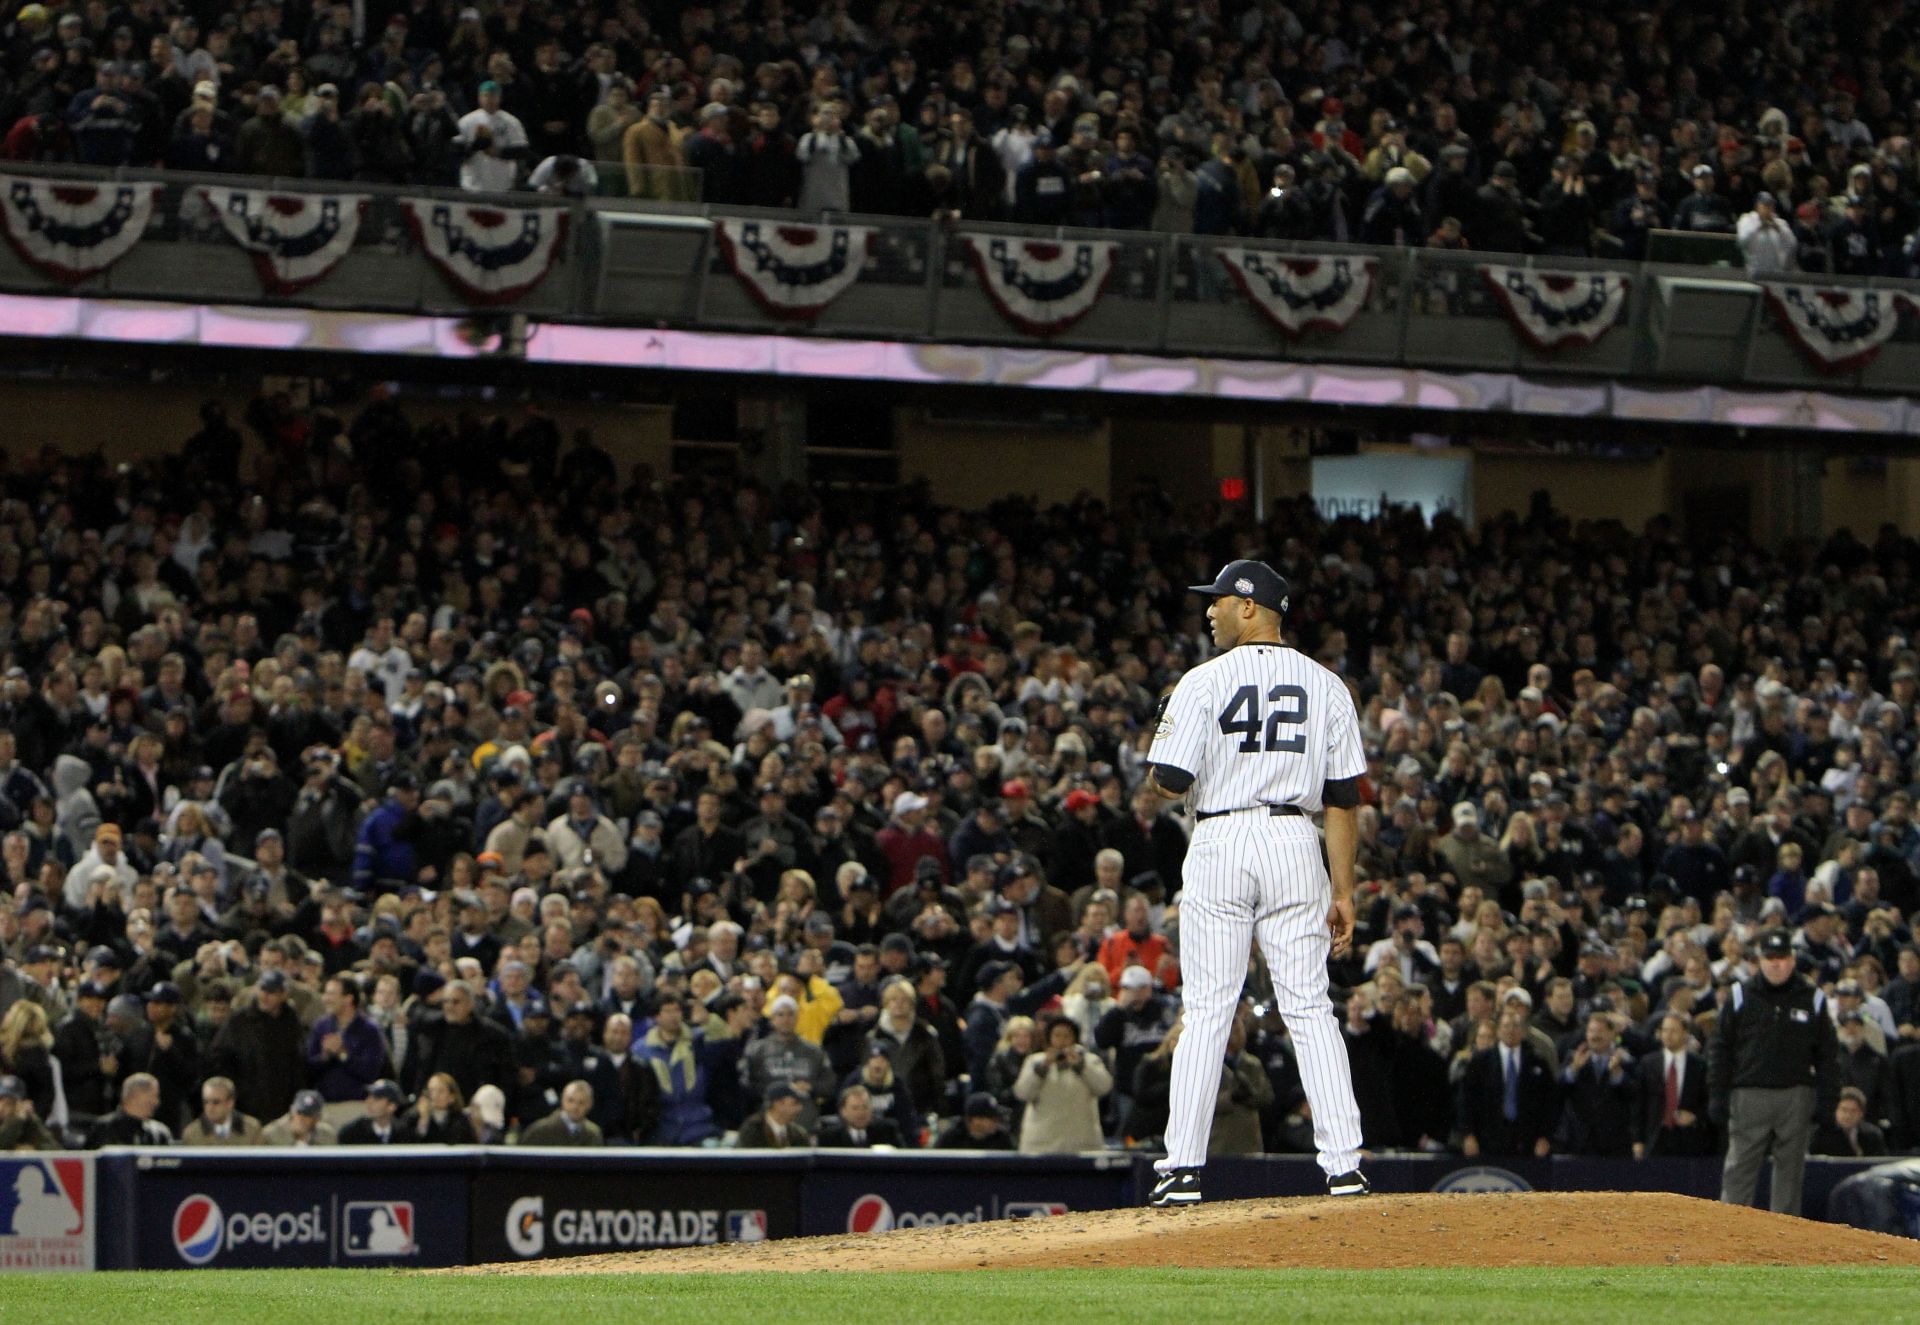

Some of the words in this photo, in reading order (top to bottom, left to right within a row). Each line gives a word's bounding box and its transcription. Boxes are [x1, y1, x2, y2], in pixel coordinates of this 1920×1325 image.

[1218, 684, 1308, 754] 42
[226, 1205, 326, 1251] pepsi
[506, 1196, 544, 1256] G
[553, 1209, 719, 1245] GATORADE
[0, 1251, 85, 1268] RNATIONAL
